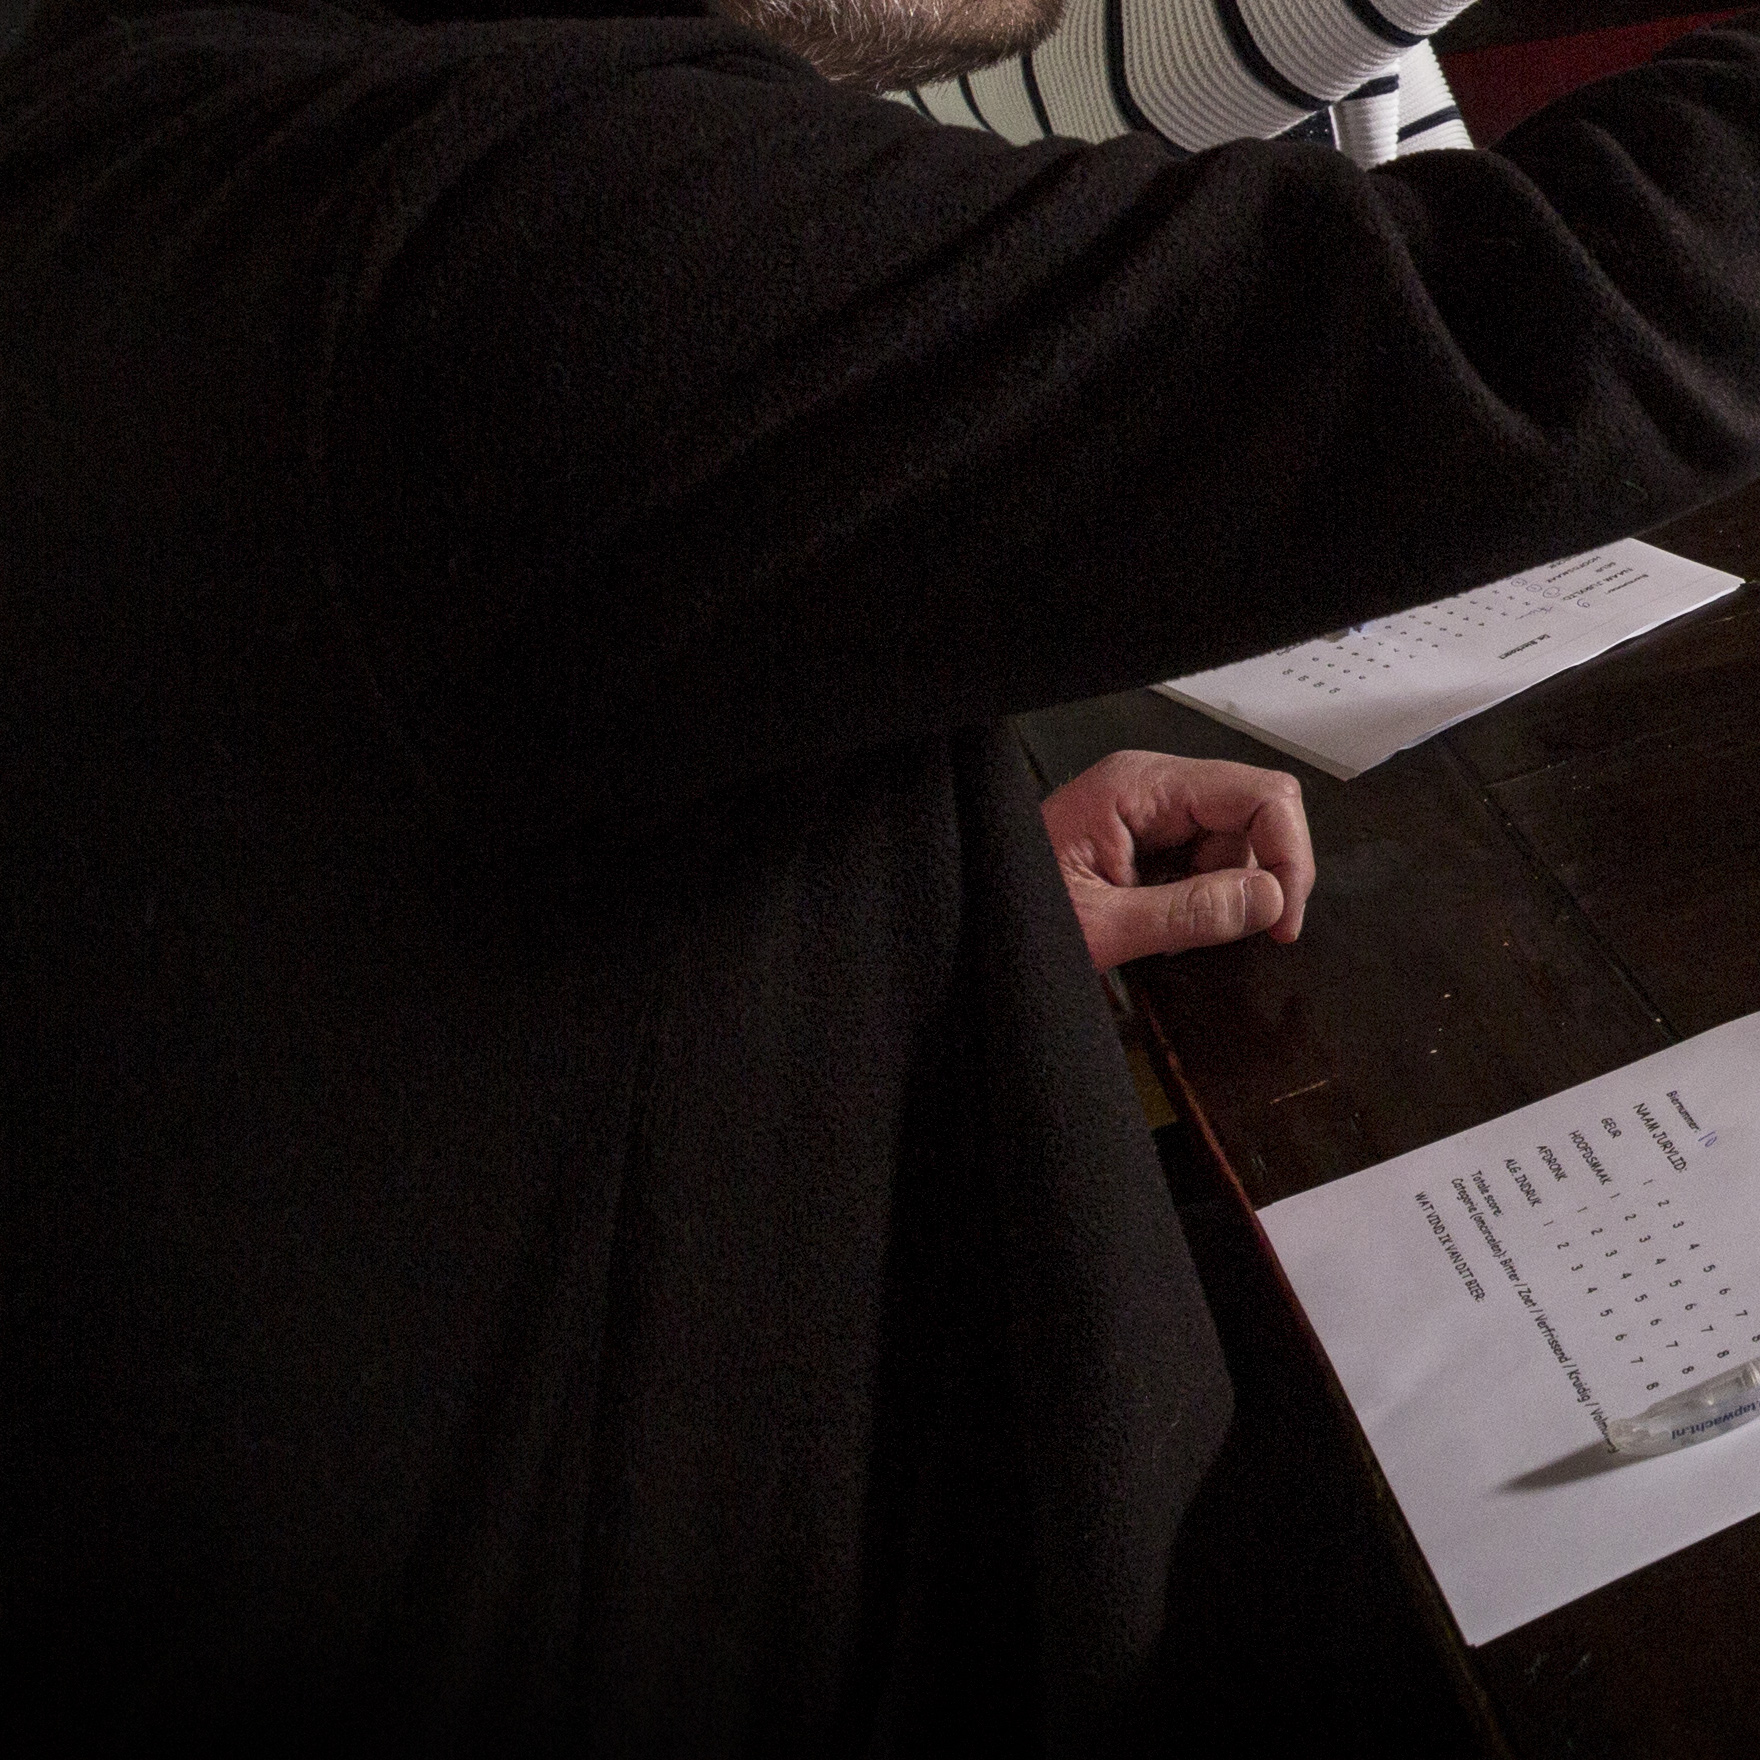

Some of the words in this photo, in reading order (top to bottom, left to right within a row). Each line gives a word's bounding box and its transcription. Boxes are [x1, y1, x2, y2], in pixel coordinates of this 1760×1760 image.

[1600, 1116, 1623, 1139] GEUR
[1632, 1102, 1658, 1134] NAAM
[1652, 1131, 1689, 1173] JURYLID:
[1536, 1144, 1569, 1183] AFDRONK
[1568, 1129, 1613, 1186] HOOFDSMAAK
[1514, 1173, 1544, 1209] INDRUK
[1450, 1176, 1476, 1214] Categorie
[1500, 1257, 1520, 1283] Bitter
[1518, 1286, 1537, 1309] Zoet
[1534, 1312, 1570, 1365] Verfrissend
[1567, 1363, 1591, 1405] Kruidig
